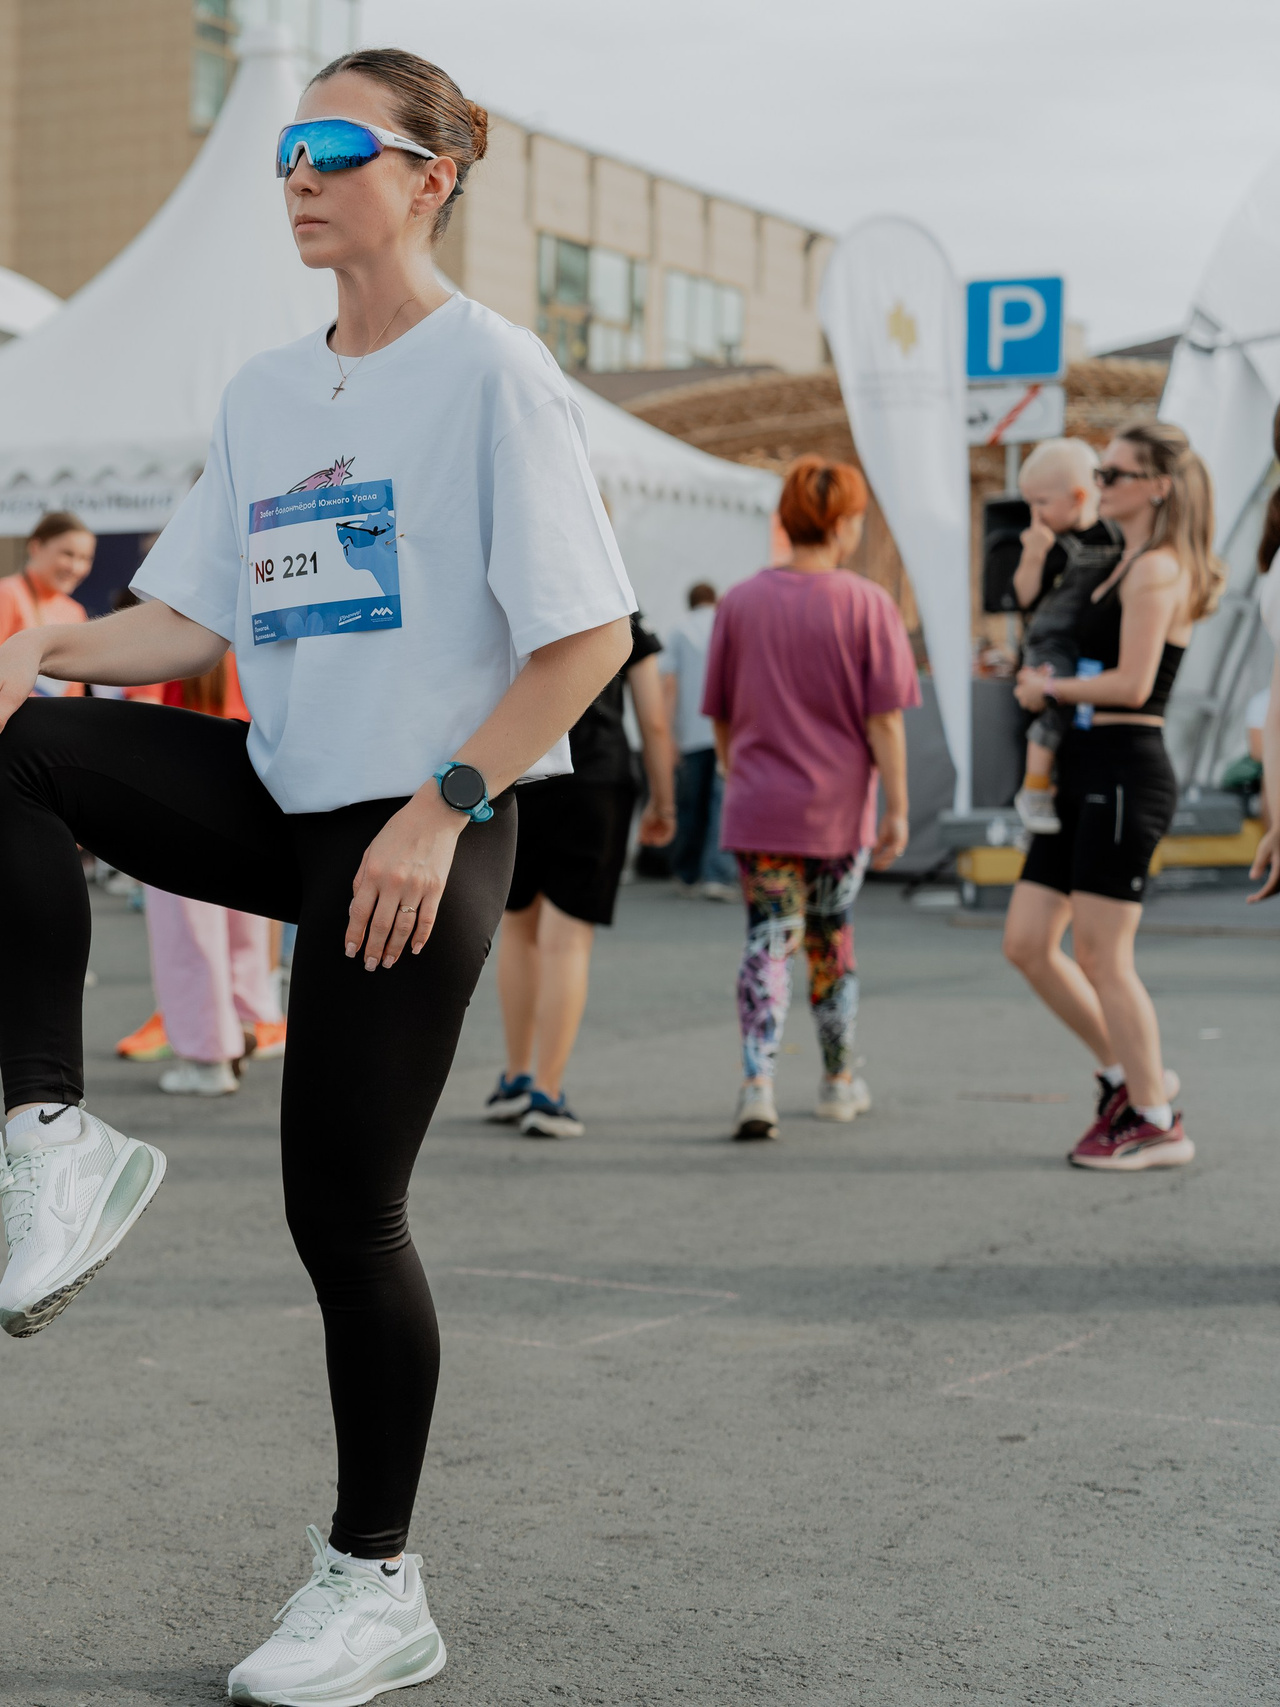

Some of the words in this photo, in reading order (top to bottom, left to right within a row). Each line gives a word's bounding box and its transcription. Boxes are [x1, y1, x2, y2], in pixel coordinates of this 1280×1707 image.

[987, 284, 1047, 373] P
[259, 509, 275, 520] Забег
[275, 499, 316, 515] волонтёров
[318, 497, 350, 508] Южного
[352, 493, 378, 503] Урала
[282, 551, 318, 579] 221
